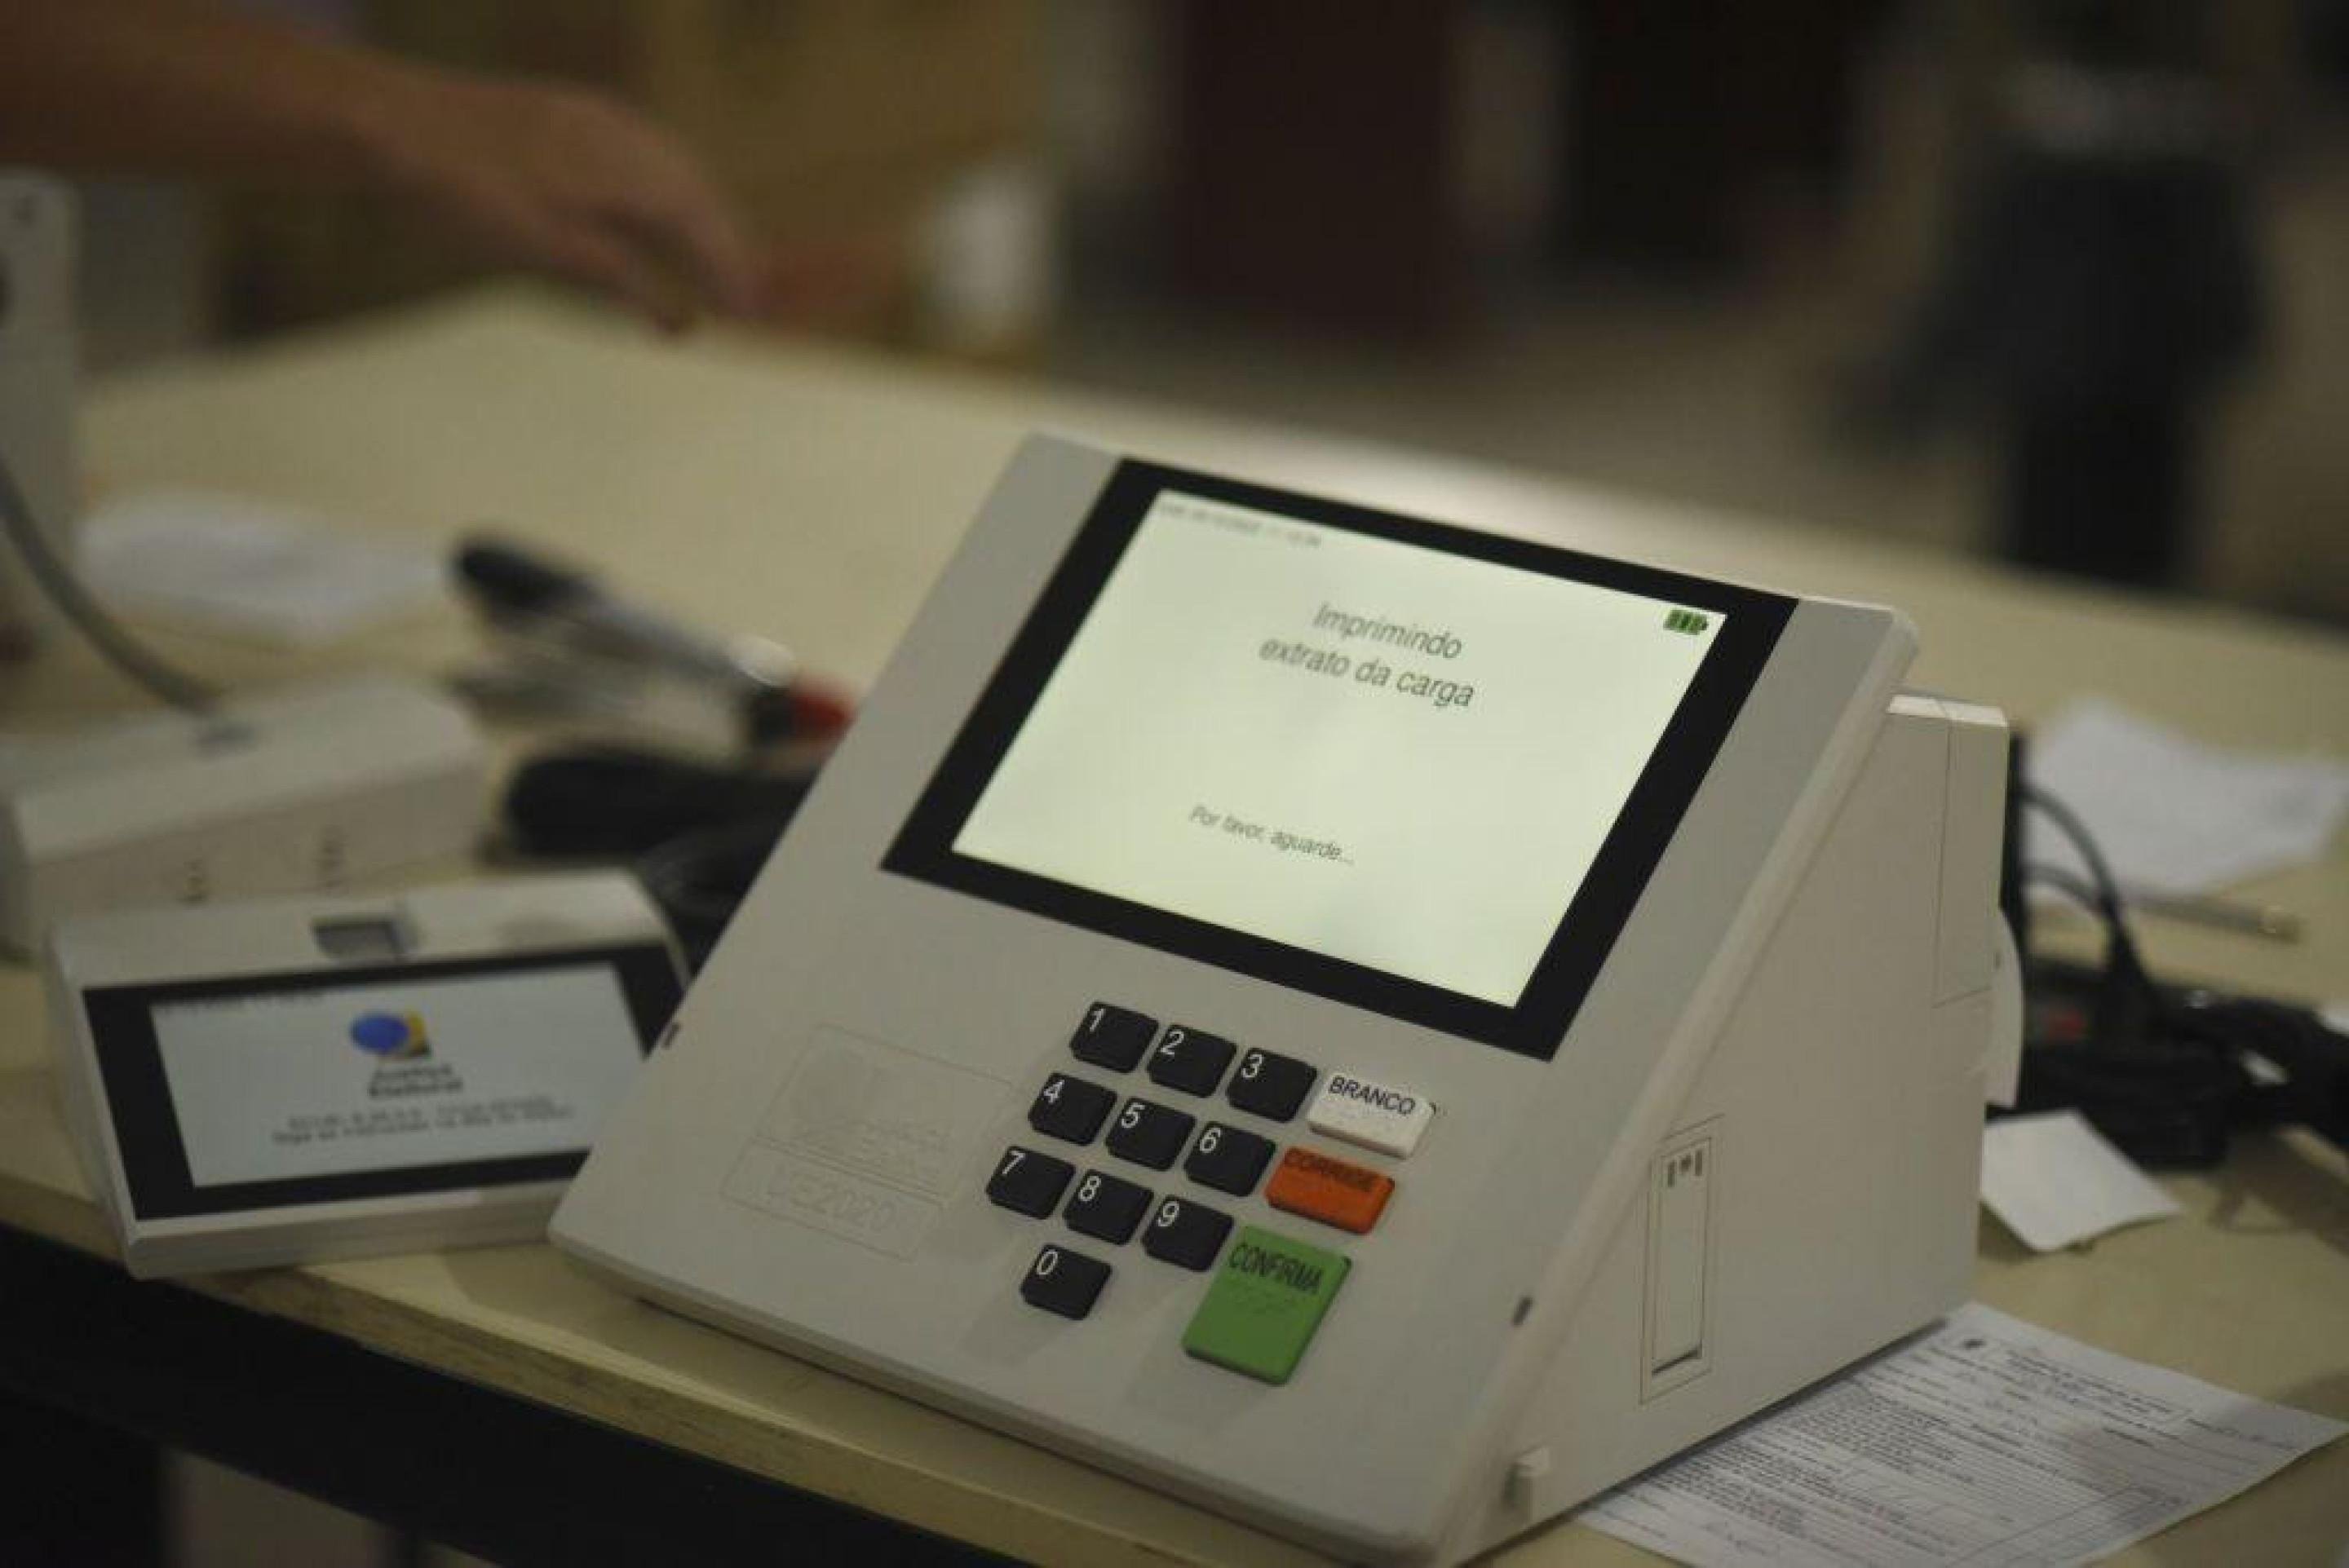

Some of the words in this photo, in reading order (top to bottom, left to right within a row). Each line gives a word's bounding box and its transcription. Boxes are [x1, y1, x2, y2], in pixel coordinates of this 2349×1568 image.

[1313, 602, 1462, 659] Imprimindo
[1259, 639, 1350, 678] extrato
[1355, 659, 1391, 687] da
[1396, 672, 1474, 708] carga
[1190, 806, 1222, 827] Por
[1089, 1008, 1104, 1031] 1
[1160, 1029, 1184, 1055] 2
[1241, 1053, 1264, 1079] 3
[1043, 1080, 1065, 1103] 4
[1329, 1075, 1416, 1116] BRANCO
[1121, 1102, 1145, 1129] 5
[1199, 1127, 1222, 1154] 6
[1002, 1150, 1026, 1175] 7
[1077, 1175, 1102, 1202] 8
[1157, 1200, 1180, 1227] 9
[1228, 1242, 1323, 1295] CONFIRMA
